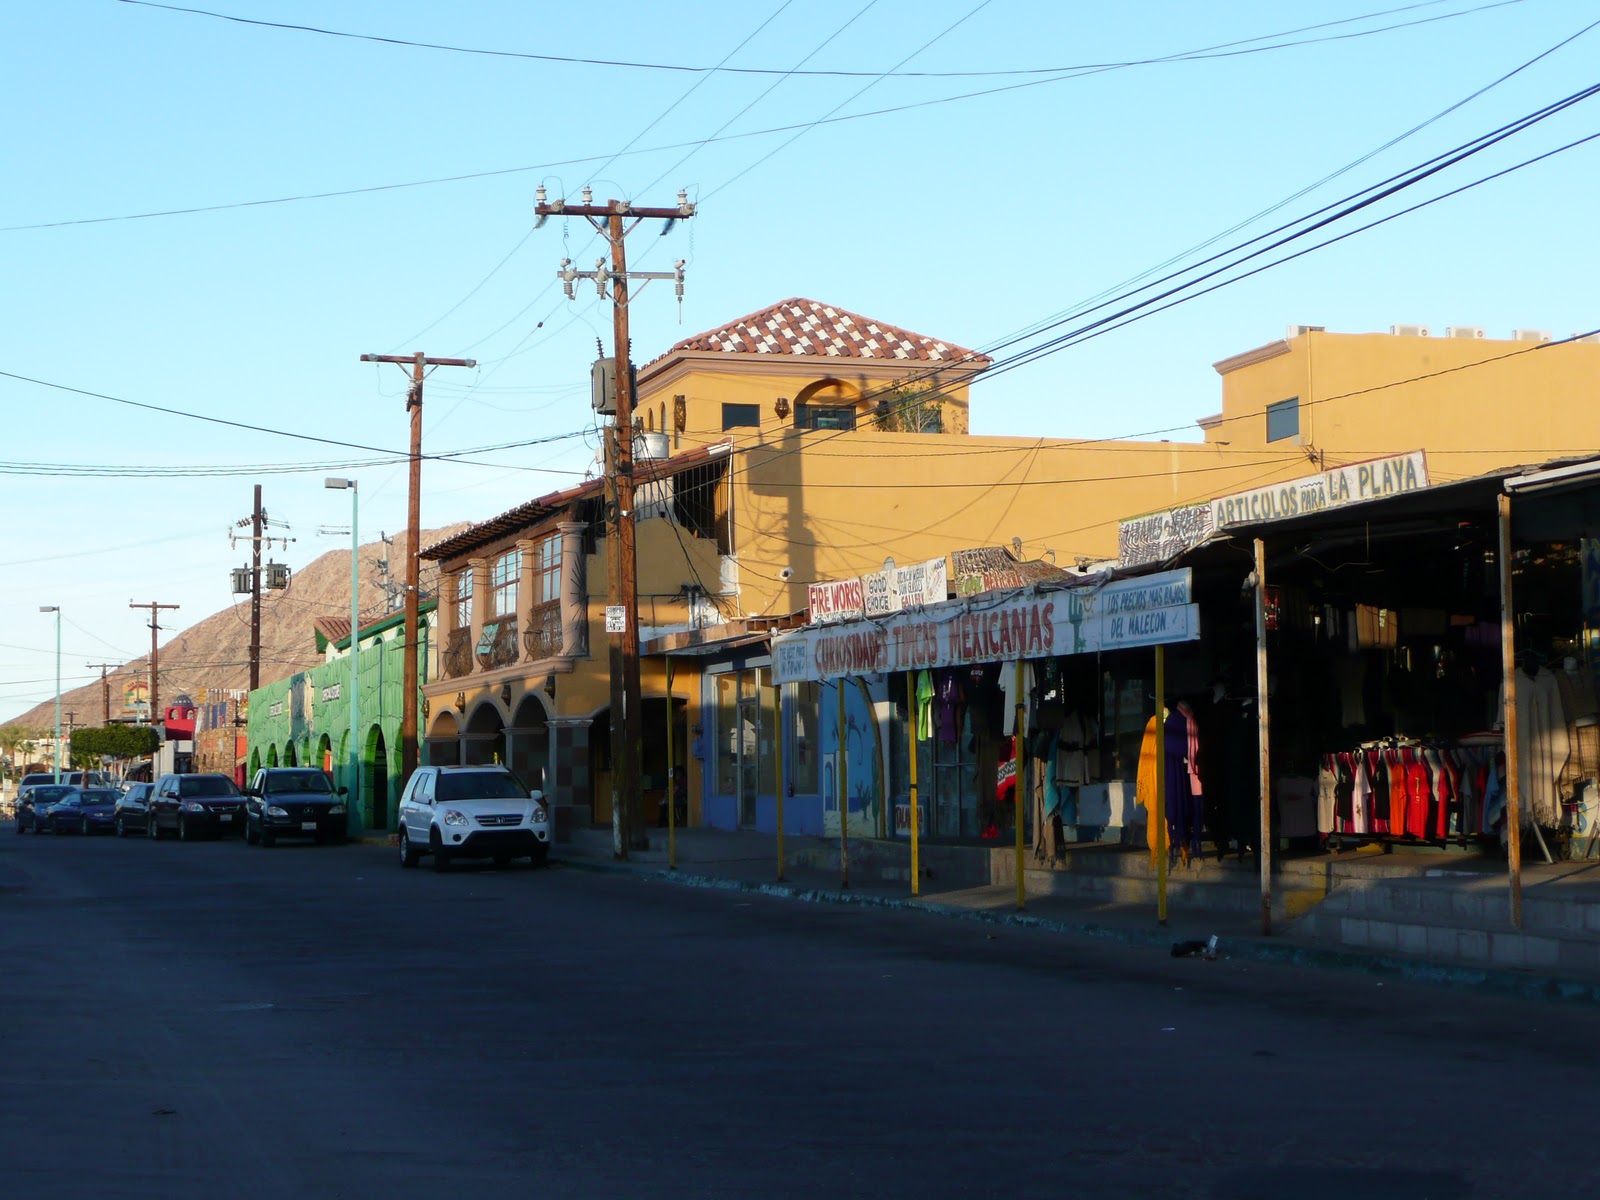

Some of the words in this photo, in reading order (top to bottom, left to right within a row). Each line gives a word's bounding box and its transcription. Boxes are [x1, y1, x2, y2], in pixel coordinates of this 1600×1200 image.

[1217, 486, 1298, 526] ARTICULOS
[1301, 486, 1326, 512] PARA
[1328, 471, 1350, 501] LA
[1358, 457, 1418, 497] PLAYA
[809, 585, 832, 614] FIRE
[830, 581, 861, 611] WORKS
[868, 576, 887, 595] GOOD
[866, 595, 889, 612] CHOICE
[948, 602, 1055, 660] MEXICANAS
[1110, 616, 1124, 639] DEL
[1128, 611, 1168, 636] MALECON
